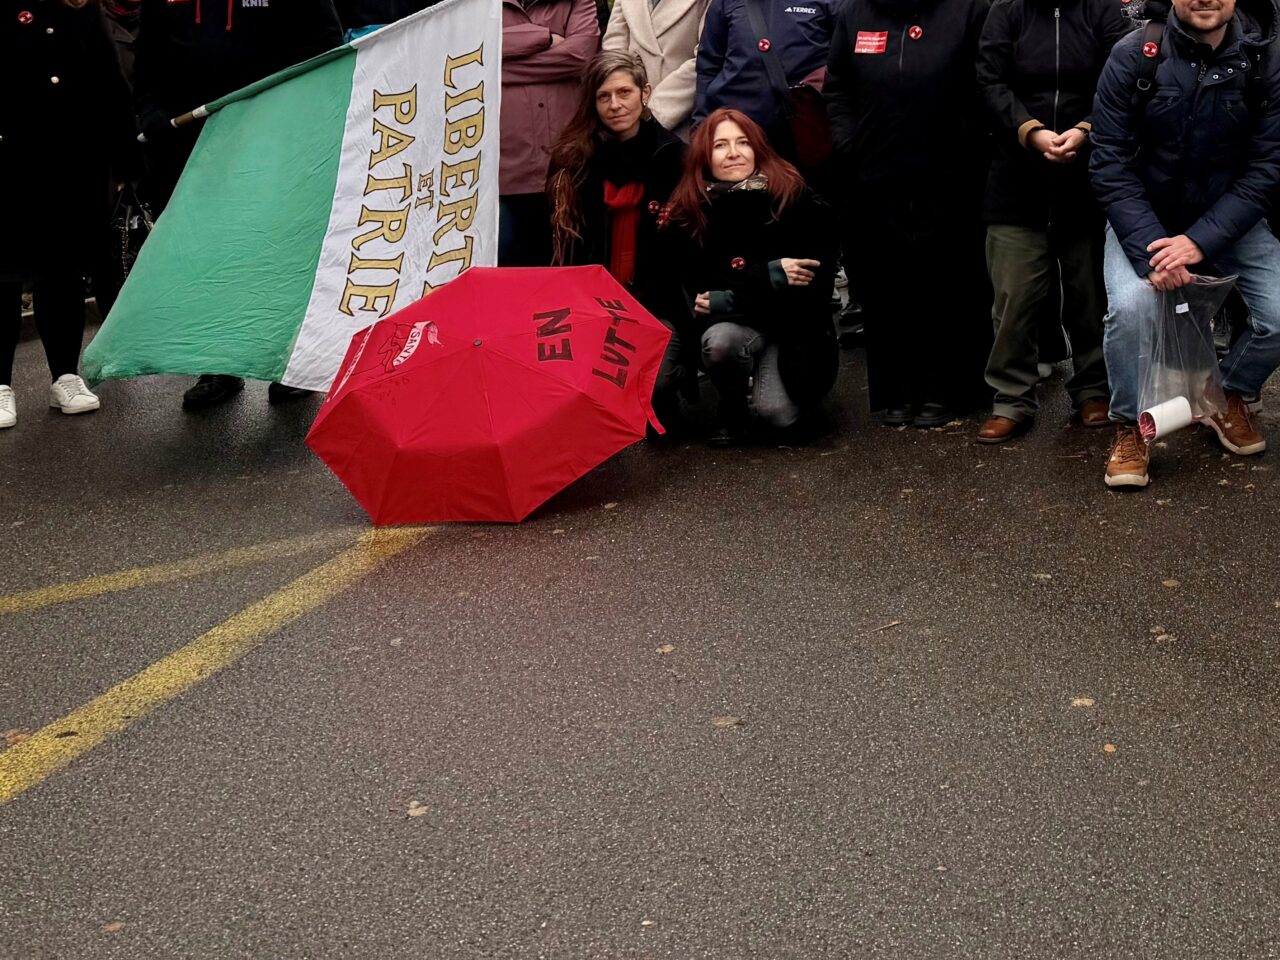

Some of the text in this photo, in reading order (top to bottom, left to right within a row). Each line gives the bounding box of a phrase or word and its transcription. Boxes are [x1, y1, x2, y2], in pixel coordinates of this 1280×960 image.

[242, 0, 269, 7] KNIE
[414, 168, 434, 210] ET
[421, 41, 485, 299] LIBERT
[338, 83, 418, 318] PATRIE
[533, 307, 573, 361] EN
